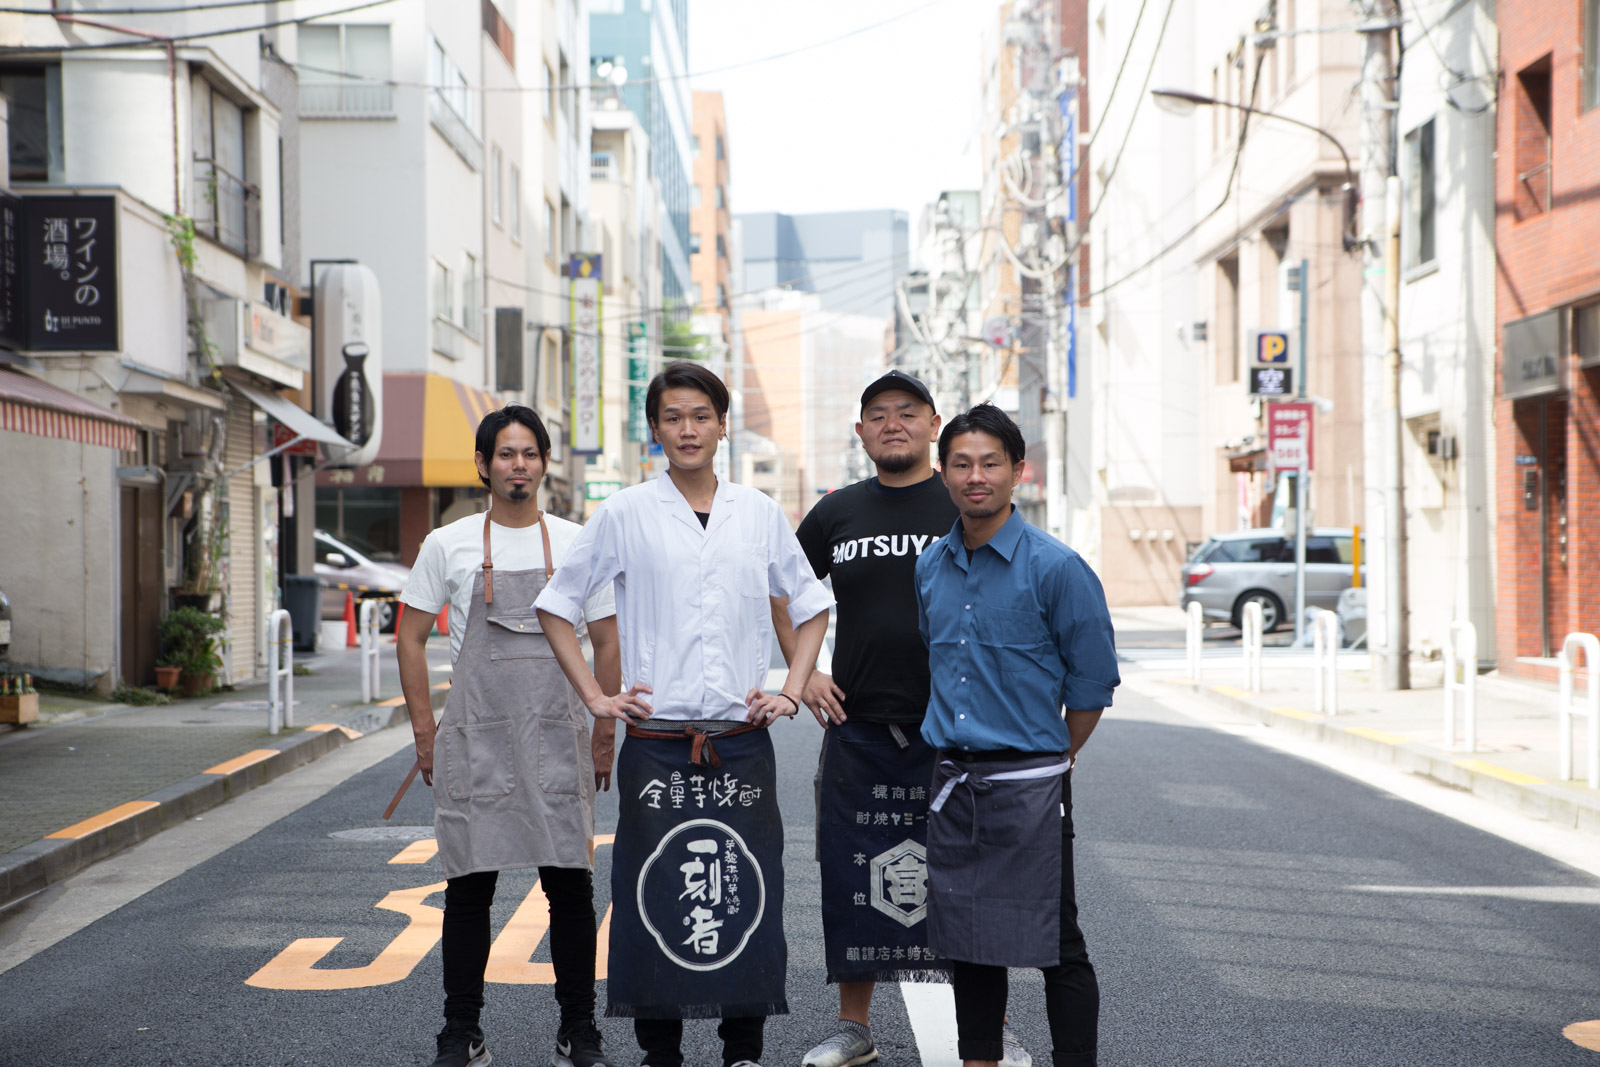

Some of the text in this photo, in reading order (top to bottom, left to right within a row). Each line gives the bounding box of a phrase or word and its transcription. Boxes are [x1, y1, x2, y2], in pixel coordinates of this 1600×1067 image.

[43, 217, 70, 280] 酒場。
[75, 217, 100, 306] ワインの
[639, 771, 762, 809] 全量芋焼酎
[678, 839, 724, 955] 一刻者
